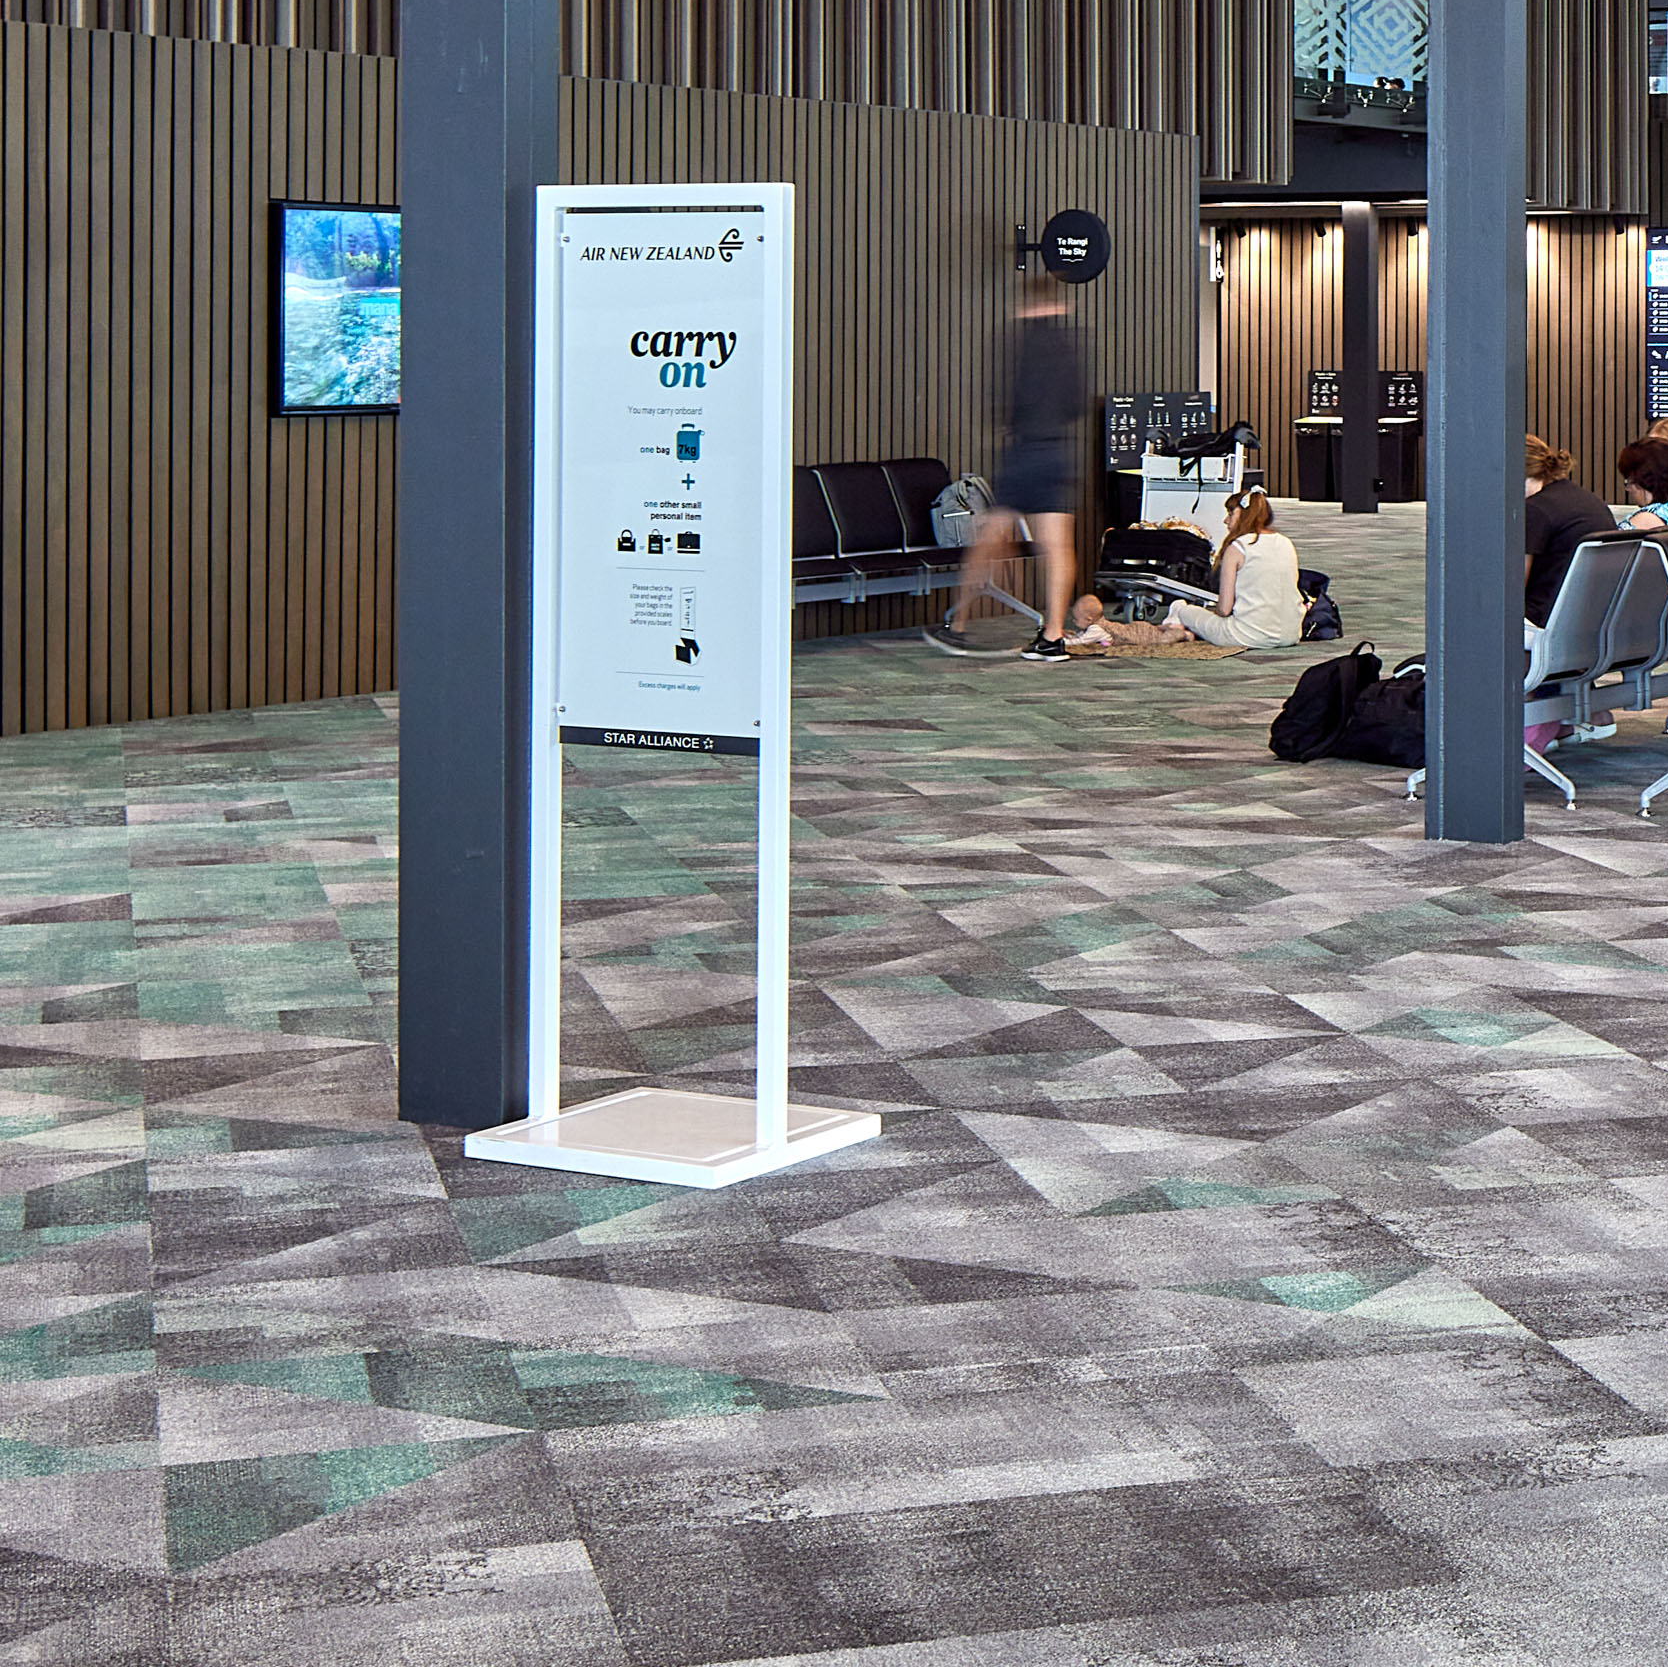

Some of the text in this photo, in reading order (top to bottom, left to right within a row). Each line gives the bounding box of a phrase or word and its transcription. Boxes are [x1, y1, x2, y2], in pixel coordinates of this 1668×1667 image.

[1056, 237, 1089, 247] Te Rangi
[580, 246, 715, 261] AIR NEW ZEALAND
[1058, 247, 1087, 257] The Sky
[630, 330, 737, 369] carry
[659, 361, 707, 388] on
[627, 406, 703, 417] You may carry onboard
[656, 445, 670, 455] bag
[678, 444, 697, 456] 7kg
[659, 500, 679, 508] other
[681, 501, 702, 509] small
[650, 512, 702, 521] personal item
[603, 731, 700, 749] STAR ALLIANCE
